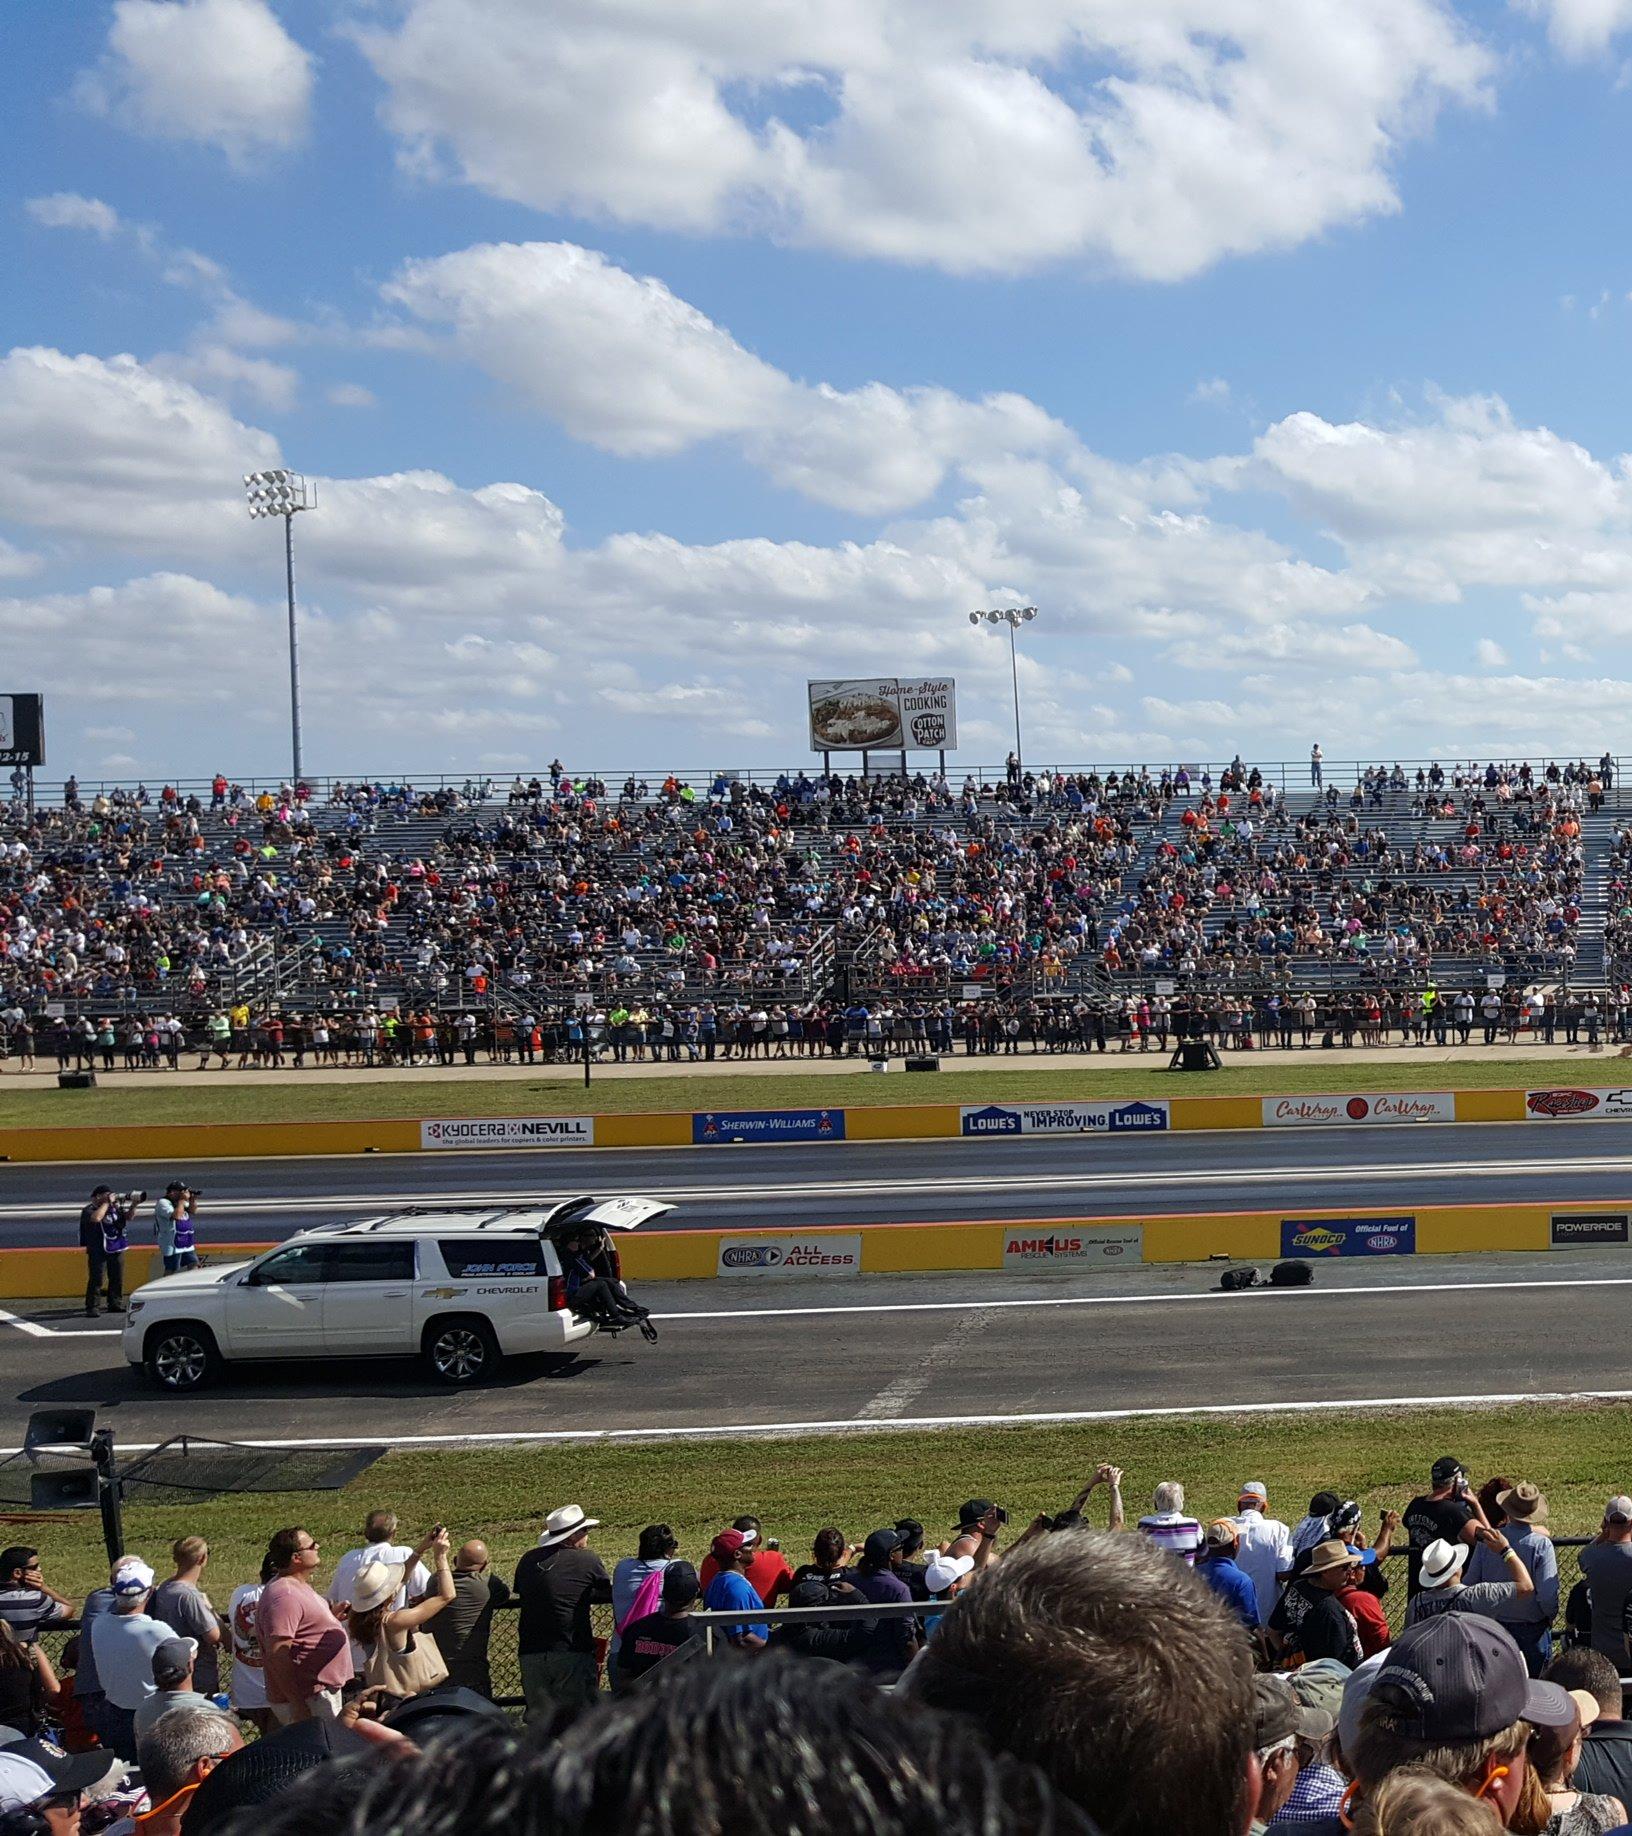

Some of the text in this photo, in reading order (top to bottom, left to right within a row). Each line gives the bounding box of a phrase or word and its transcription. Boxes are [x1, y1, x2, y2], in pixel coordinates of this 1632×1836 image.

[879, 682, 949, 695] Home-Style
[904, 696, 947, 711] COOKING
[911, 714, 944, 730] COTTON
[917, 728, 945, 744] PATCH
[1023, 1109, 1074, 1118] NEVER STOP
[1115, 1112, 1161, 1126] LOWE'S
[721, 1119, 816, 1131] SHERWIN-WILLIAMS
[969, 1116, 1016, 1130] LOWE'S
[1032, 1114, 1108, 1128] IMPROVING.
[522, 1122, 587, 1135] NEVILL
[1356, 1224, 1381, 1233] Official
[1383, 1224, 1399, 1232] Fuel
[1557, 1222, 1622, 1231] POWERADE
[1295, 1234, 1344, 1245] SUNOCO
[1371, 1237, 1394, 1247] NHRA
[790, 1246, 822, 1255] ALL
[1054, 1251, 1087, 1259] SYSTEMS
[730, 1251, 758, 1264] NHRA
[783, 1254, 854, 1266] ACCESS
[461, 1262, 537, 1272] JOHN FORCE
[477, 1286, 539, 1295] CHEVROLET
